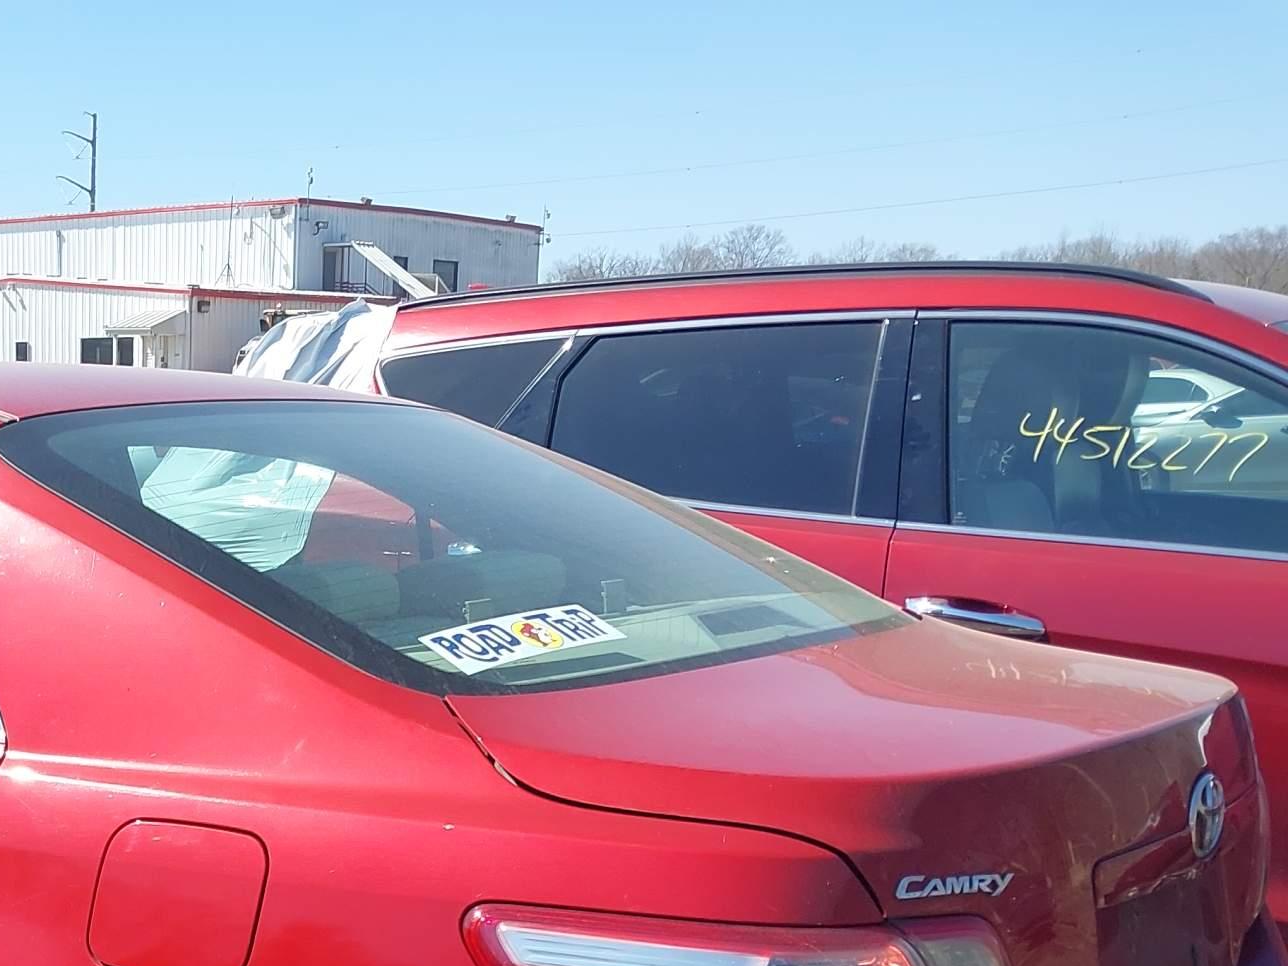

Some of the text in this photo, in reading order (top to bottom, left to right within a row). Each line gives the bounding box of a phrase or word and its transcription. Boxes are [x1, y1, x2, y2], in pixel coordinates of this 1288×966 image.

[1018, 407, 1269, 482] 44512277
[429, 623, 522, 663] ROAD
[895, 872, 1016, 900] CAMRY
